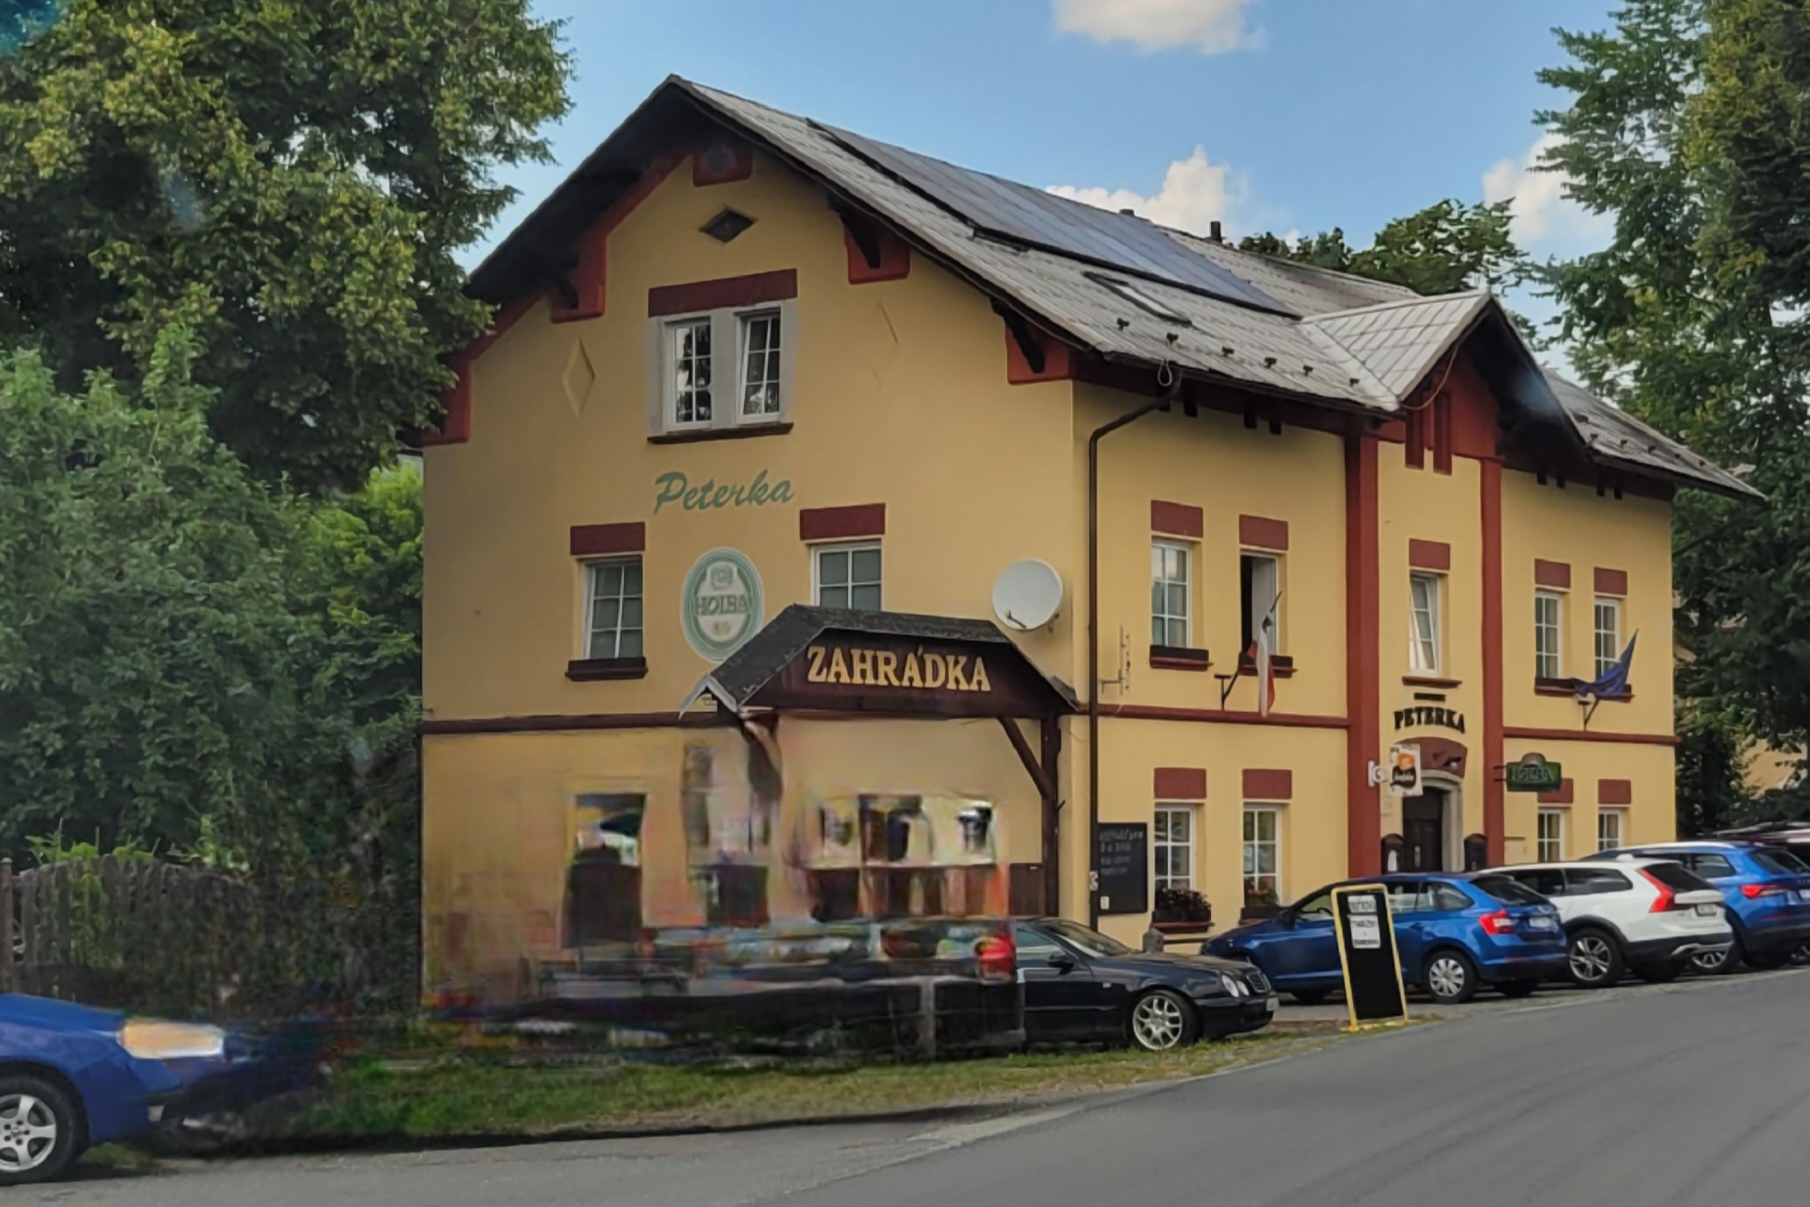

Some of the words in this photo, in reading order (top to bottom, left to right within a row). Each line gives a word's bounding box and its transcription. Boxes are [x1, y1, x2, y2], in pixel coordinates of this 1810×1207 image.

[655, 468, 795, 514] Peterka
[695, 594, 749, 616] HOLBA
[807, 644, 991, 691] ZAHRÁDKA
[1394, 705, 1466, 734] PETERKA
